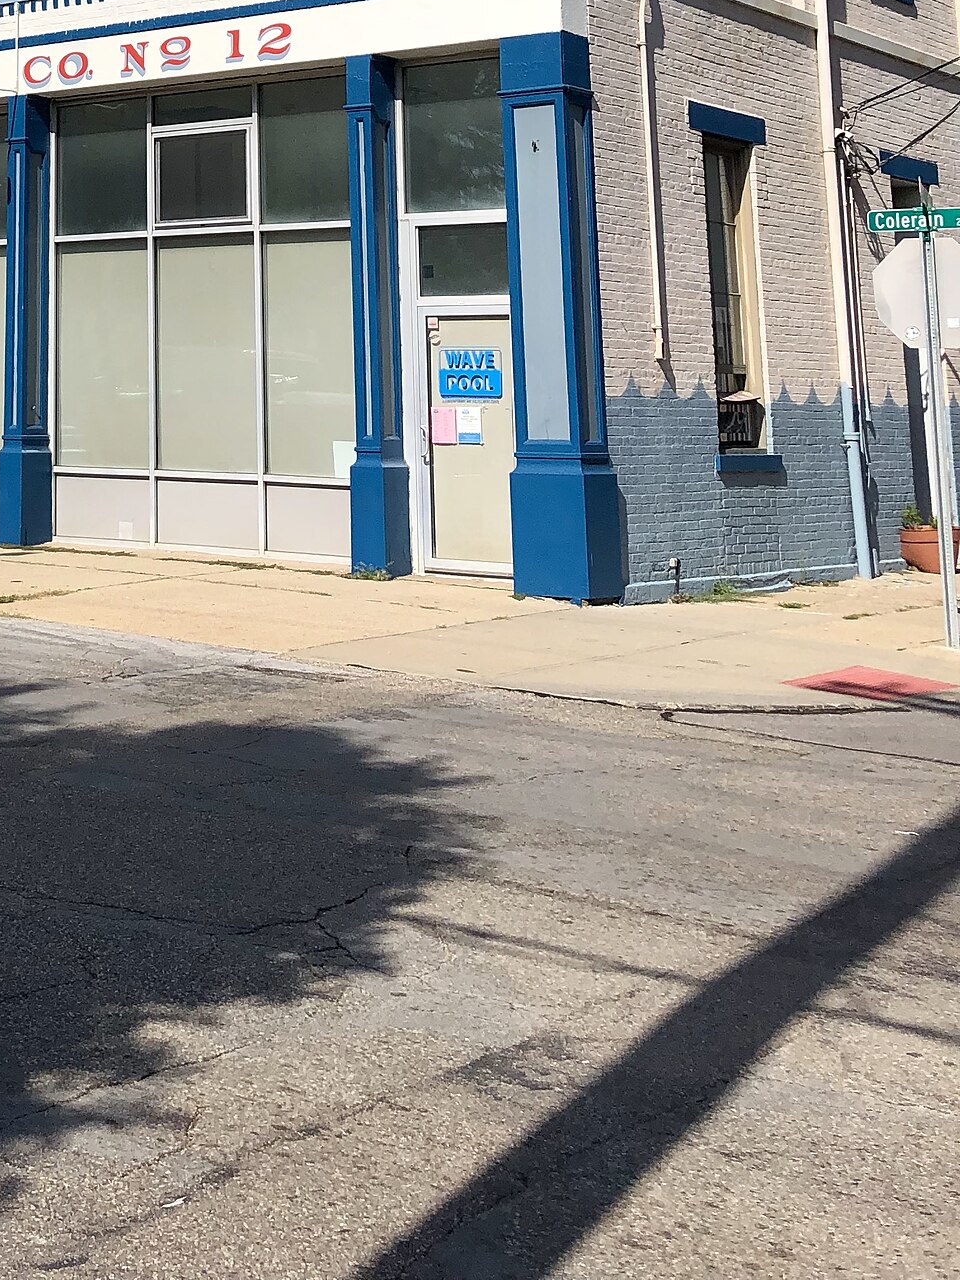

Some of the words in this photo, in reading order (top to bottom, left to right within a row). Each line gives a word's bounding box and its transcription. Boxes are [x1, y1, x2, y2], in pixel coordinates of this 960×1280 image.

[23, 51, 93, 89] CO.
[226, 23, 292, 63] 12
[875, 212, 944, 229] Colerain
[444, 350, 495, 369] WAVE
[446, 374, 494, 391] POOL
